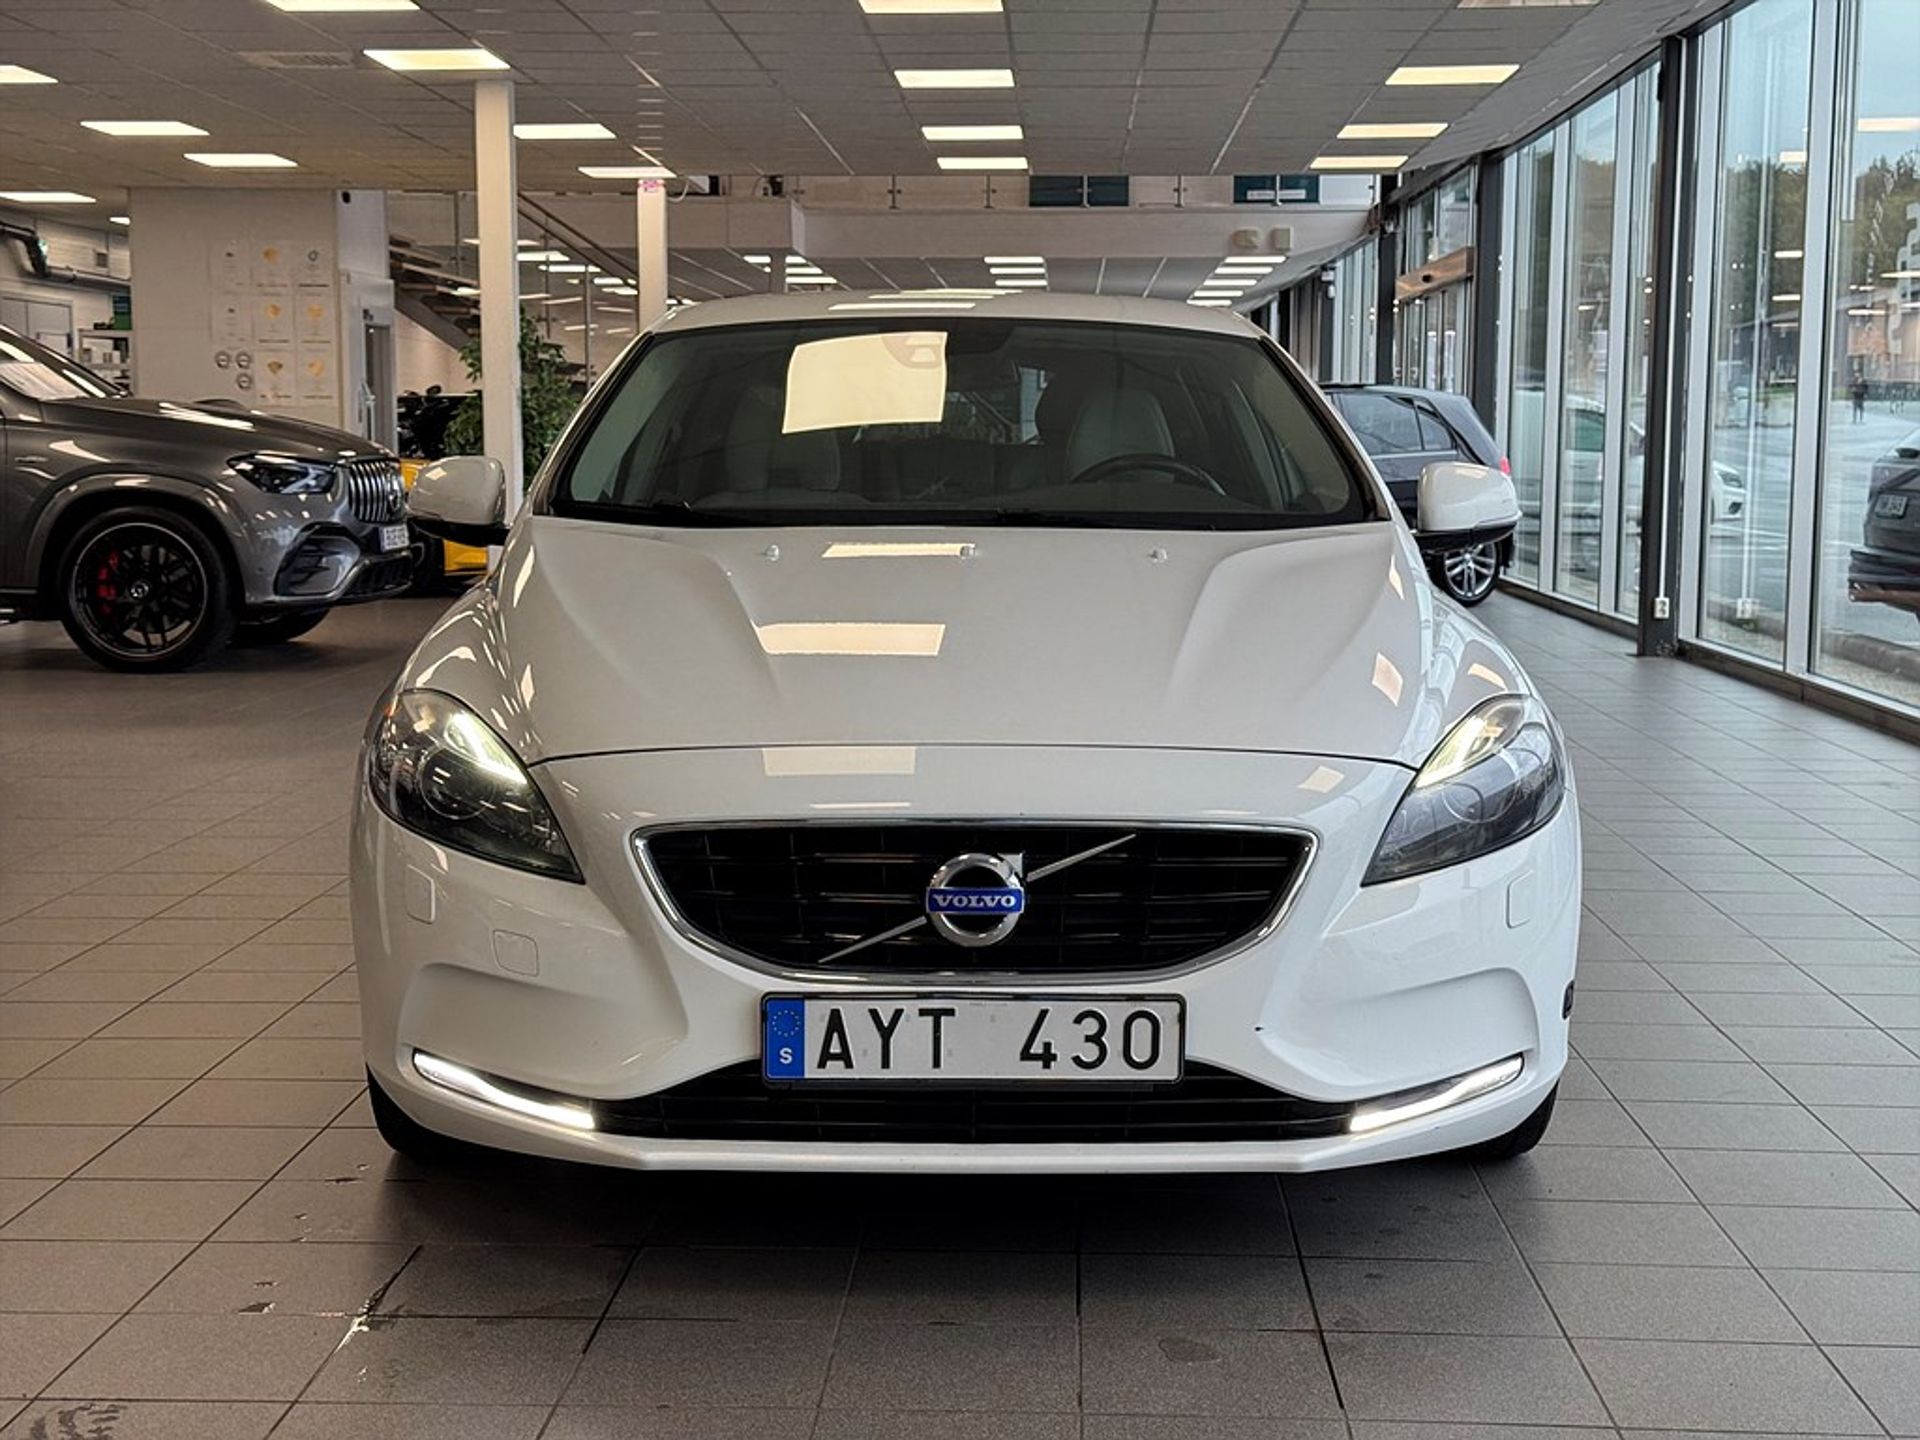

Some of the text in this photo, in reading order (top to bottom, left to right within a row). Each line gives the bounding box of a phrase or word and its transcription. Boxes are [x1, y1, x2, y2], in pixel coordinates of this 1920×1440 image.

[933, 894, 1016, 907] VOLVO
[817, 1008, 1161, 1070] AYT 430
[779, 1047, 793, 1064] S
